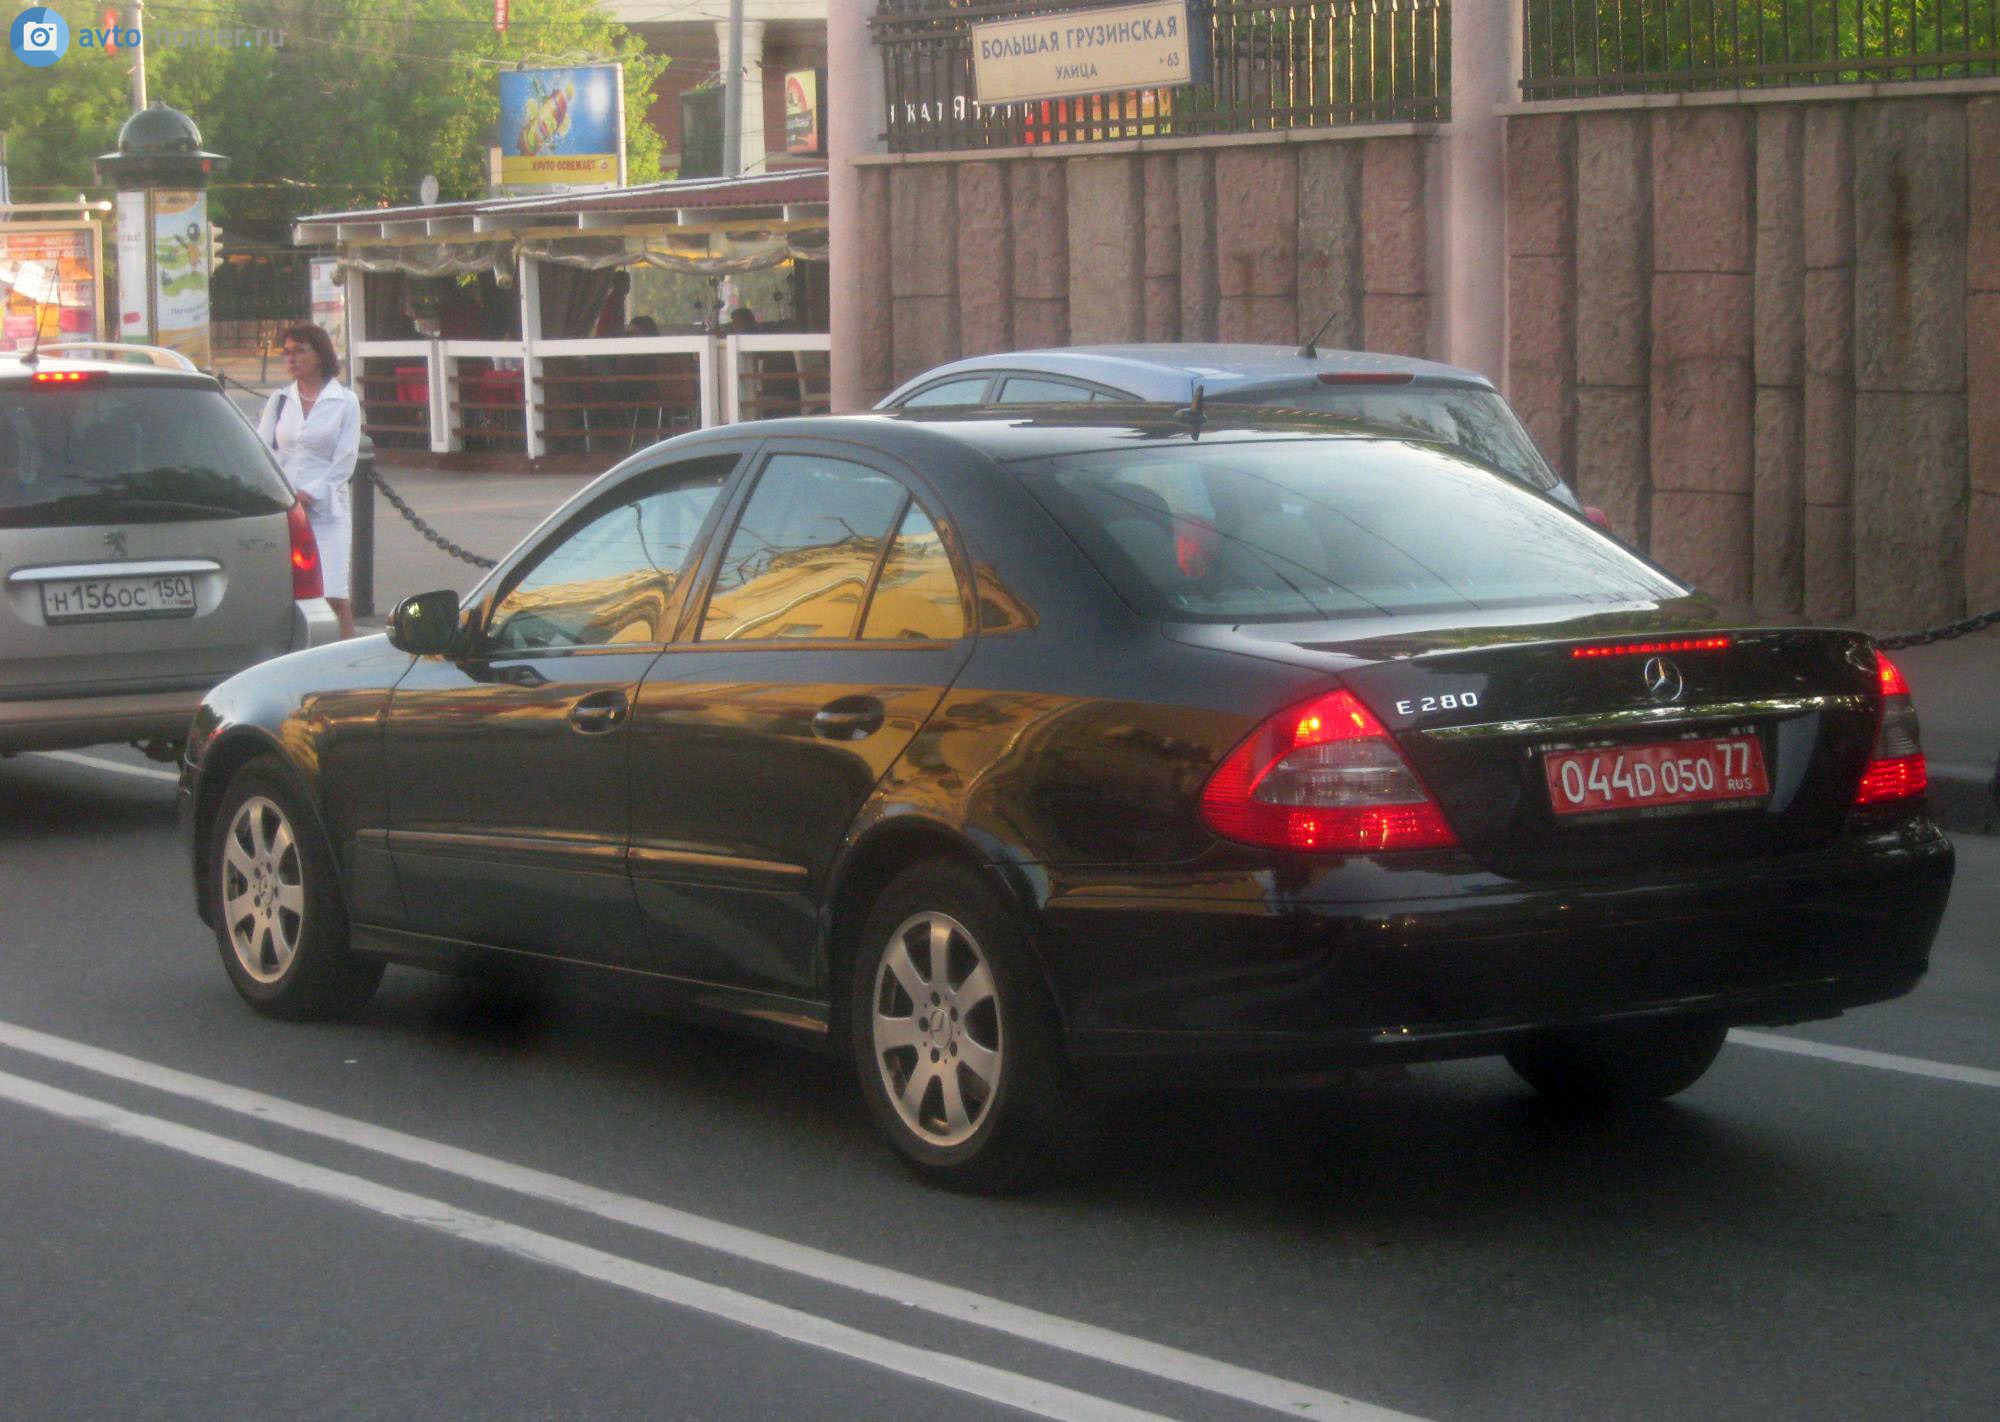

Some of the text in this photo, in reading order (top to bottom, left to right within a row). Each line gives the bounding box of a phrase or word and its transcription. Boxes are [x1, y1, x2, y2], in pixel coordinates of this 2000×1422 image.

[981, 15, 1178, 59] БОЛЬШАЯ ГРУЗИНСКАЯ
[1166, 52, 1179, 67] 63
[1055, 63, 1098, 79] УЛИЦА
[153, 578, 187, 598] 150
[1396, 692, 1479, 715] E 280
[1561, 742, 1749, 804] 044D050 77
[1727, 777, 1752, 791] RUS
